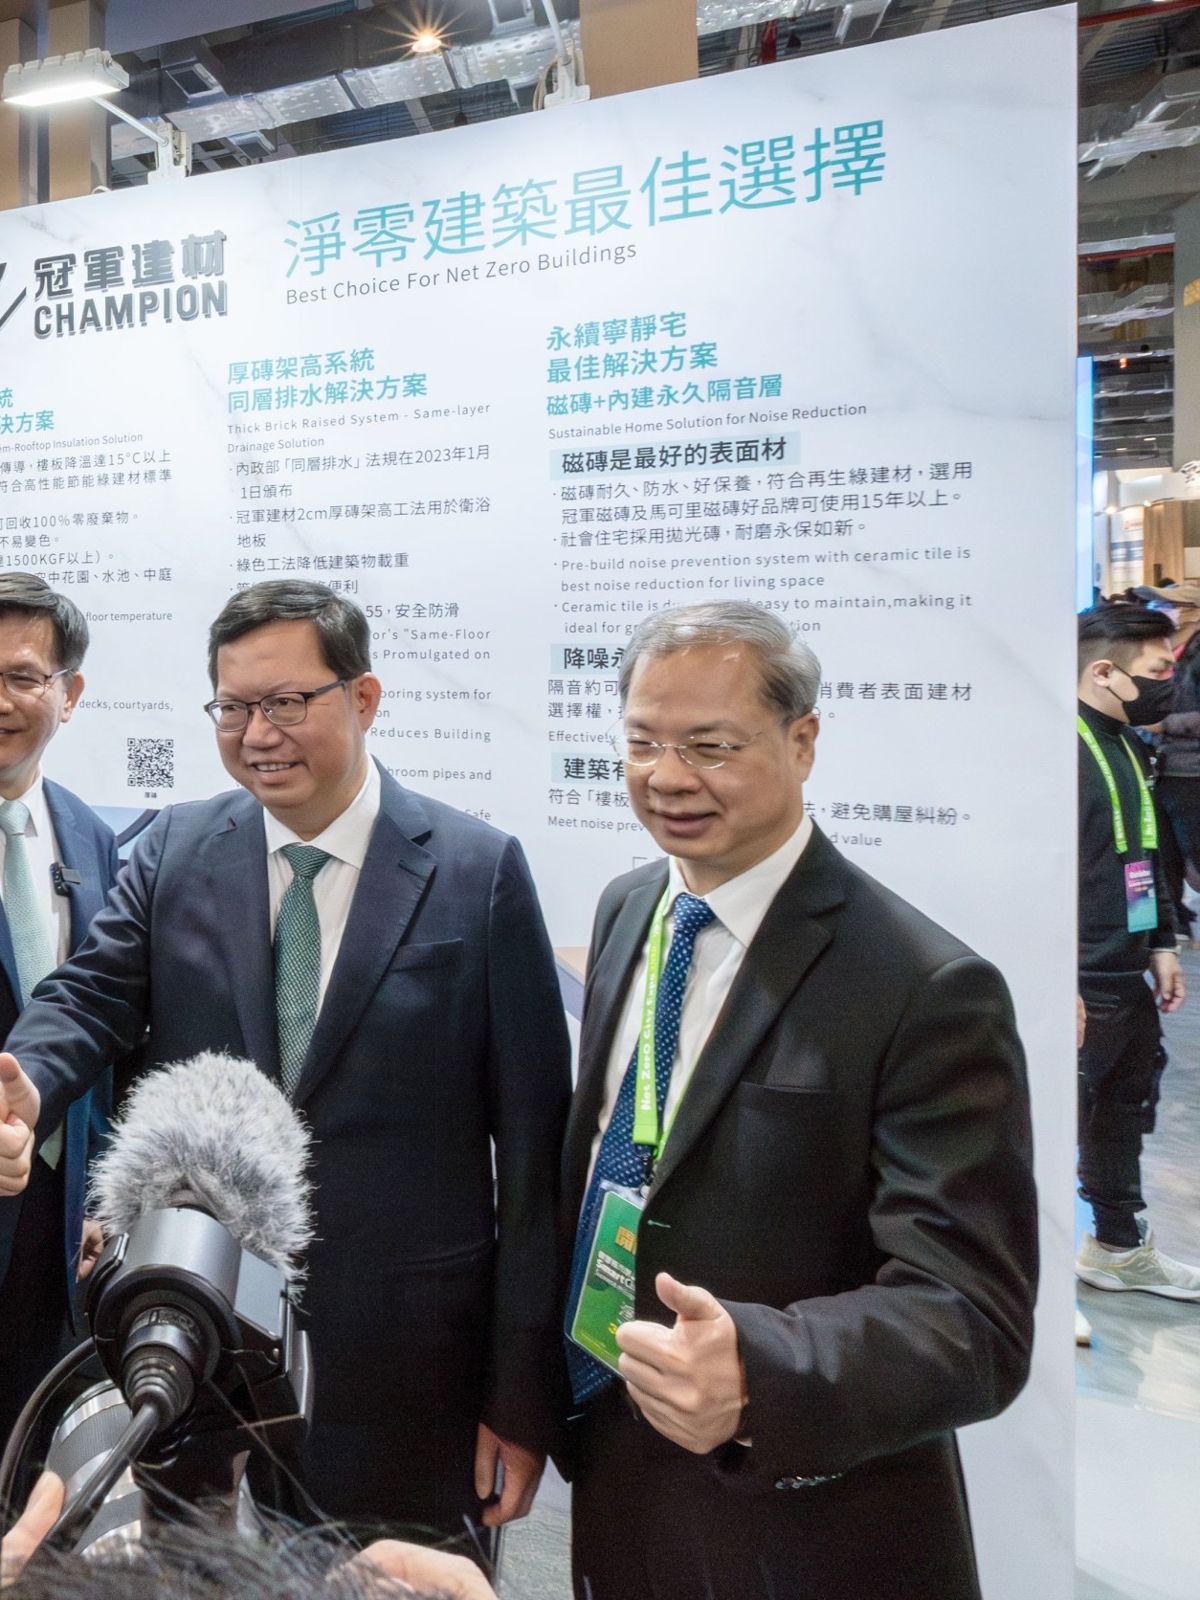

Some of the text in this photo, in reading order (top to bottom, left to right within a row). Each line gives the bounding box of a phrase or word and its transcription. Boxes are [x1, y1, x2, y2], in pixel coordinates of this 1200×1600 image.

[284, 119, 886, 279] 淨零建築最佳選擇
[33, 230, 227, 299] 冠軍建材
[286, 242, 637, 305] Best Choice For Net Zero Buildings
[33, 281, 228, 338] CHAMPION
[546, 311, 687, 351] 永續寧靜宅
[227, 347, 375, 385] 厚磚架高系統
[546, 341, 718, 384] 最佳解決方案
[227, 372, 427, 414] 同層排水解決方案
[546, 373, 782, 416] 磁磚+內建永久隔音層
[227, 423, 261, 435] Thick
[265, 420, 297, 432] Brick
[302, 416, 346, 429] Raised
[350, 412, 399, 426] System
[413, 403, 491, 420] Same-layer
[548, 403, 867, 440] Sustainable Home Solution for Noise Reduction
[53, 435, 100, 449] Insulation
[102, 432, 143, 446] Solution
[227, 436, 325, 453] Drainage Solution
[562, 436, 788, 474] 磁磚是最好的表面材
[241, 483, 293, 499] 1日頒布
[236, 533, 266, 548] 地板
[236, 552, 409, 572] 綠色工法降低建築物載重
[561, 546, 972, 573] Pre-build noise prevention system with ceramic tile is
[561, 574, 825, 592] best noise reduction for living space
[561, 600, 617, 615] Ceramic
[620, 600, 644, 612] tile
[648, 598, 658, 611] is
[794, 597, 810, 610] to
[814, 594, 955, 610] maintain,making
[959, 594, 973, 607] it
[85, 612, 108, 622] floor
[110, 611, 173, 623] temperature
[564, 621, 597, 634] ideal
[601, 620, 622, 633] for
[383, 648, 470, 662] Promulgated
[474, 651, 491, 660] on
[78, 699, 111, 710] decks,
[113, 701, 174, 713] courtyards,
[380, 688, 492, 701] ooring system for
[370, 727, 492, 743] Reduces Building
[432, 768, 466, 781] pipes
[469, 769, 492, 781] and
[547, 815, 577, 828] Meet
[580, 817, 614, 830] noise
[842, 833, 883, 847] value
